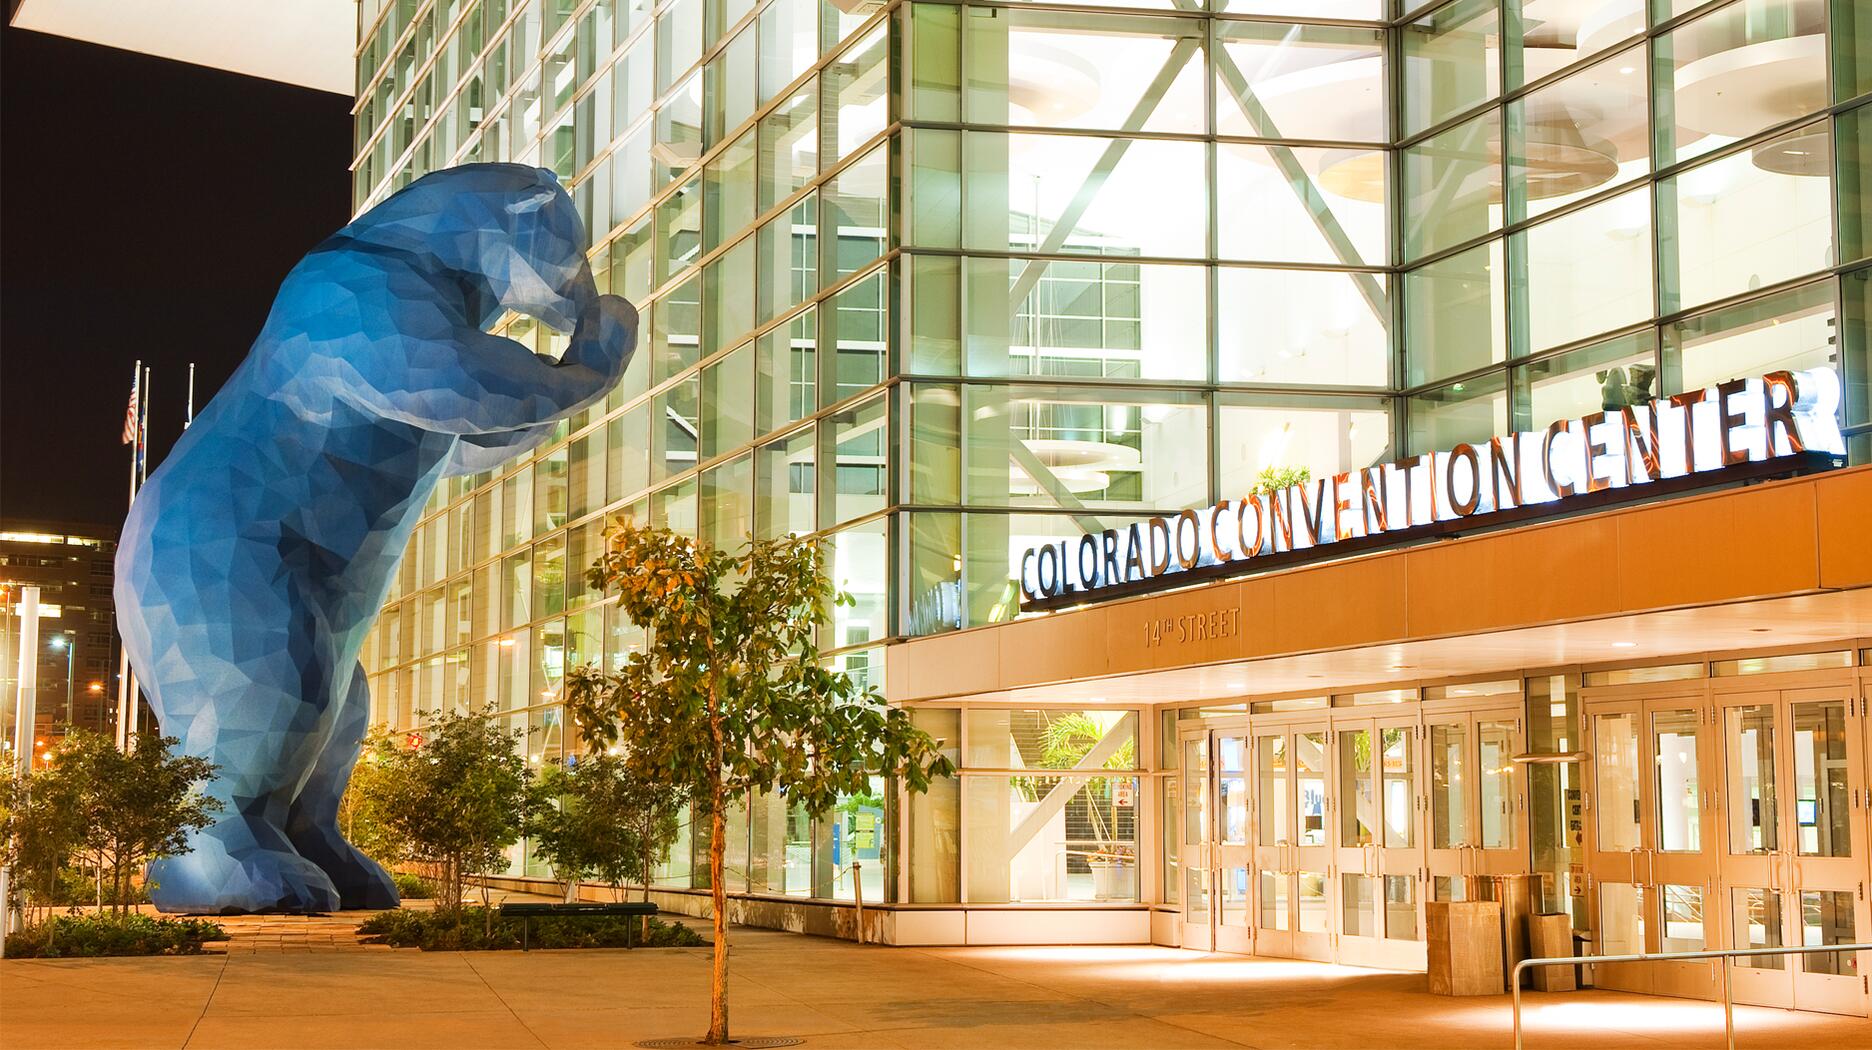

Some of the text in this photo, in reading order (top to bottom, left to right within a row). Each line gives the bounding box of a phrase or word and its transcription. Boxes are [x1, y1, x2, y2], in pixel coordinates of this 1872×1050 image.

[1021, 370, 1805, 600] COLORADO CONVENTION CENTER
[1144, 607, 1240, 648] 14TH STREET
